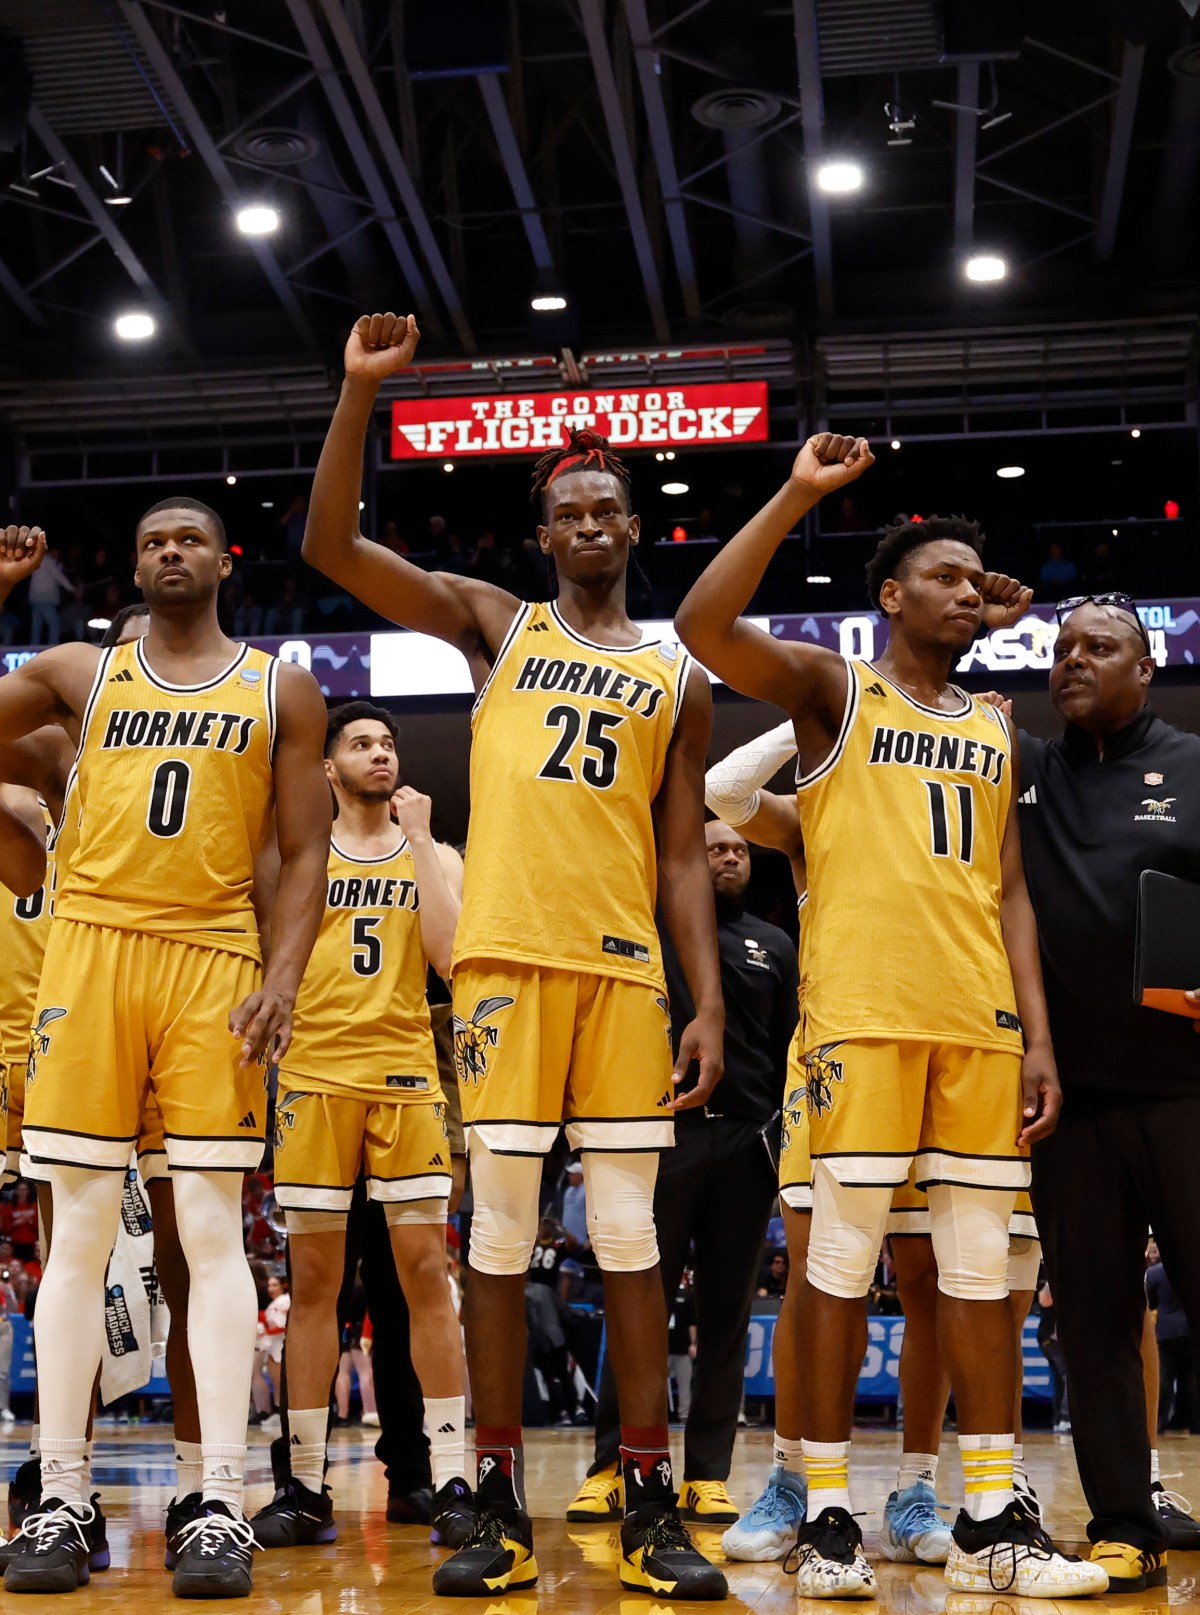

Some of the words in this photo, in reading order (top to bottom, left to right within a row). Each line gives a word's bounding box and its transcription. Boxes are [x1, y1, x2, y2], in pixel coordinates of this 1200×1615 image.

[472, 399, 534, 419] THE
[552, 391, 685, 415] CONNOR
[426, 414, 596, 452] FLIGHT
[607, 407, 732, 443] DECK
[839, 617, 874, 662] 0
[512, 655, 667, 720] HORNETS
[100, 709, 260, 756] HORNETS
[535, 703, 629, 790] 25
[866, 726, 1009, 787] HORNETS
[145, 758, 192, 839] 0
[919, 778, 974, 866] 11
[1133, 814, 1177, 823] BASKETBALL
[327, 877, 420, 912] ORNETS
[351, 915, 385, 978] 5
[130, 1181, 146, 1216] MARCH
[105, 1305, 125, 1355] MADNESS
[114, 1297, 131, 1334] MARCH
